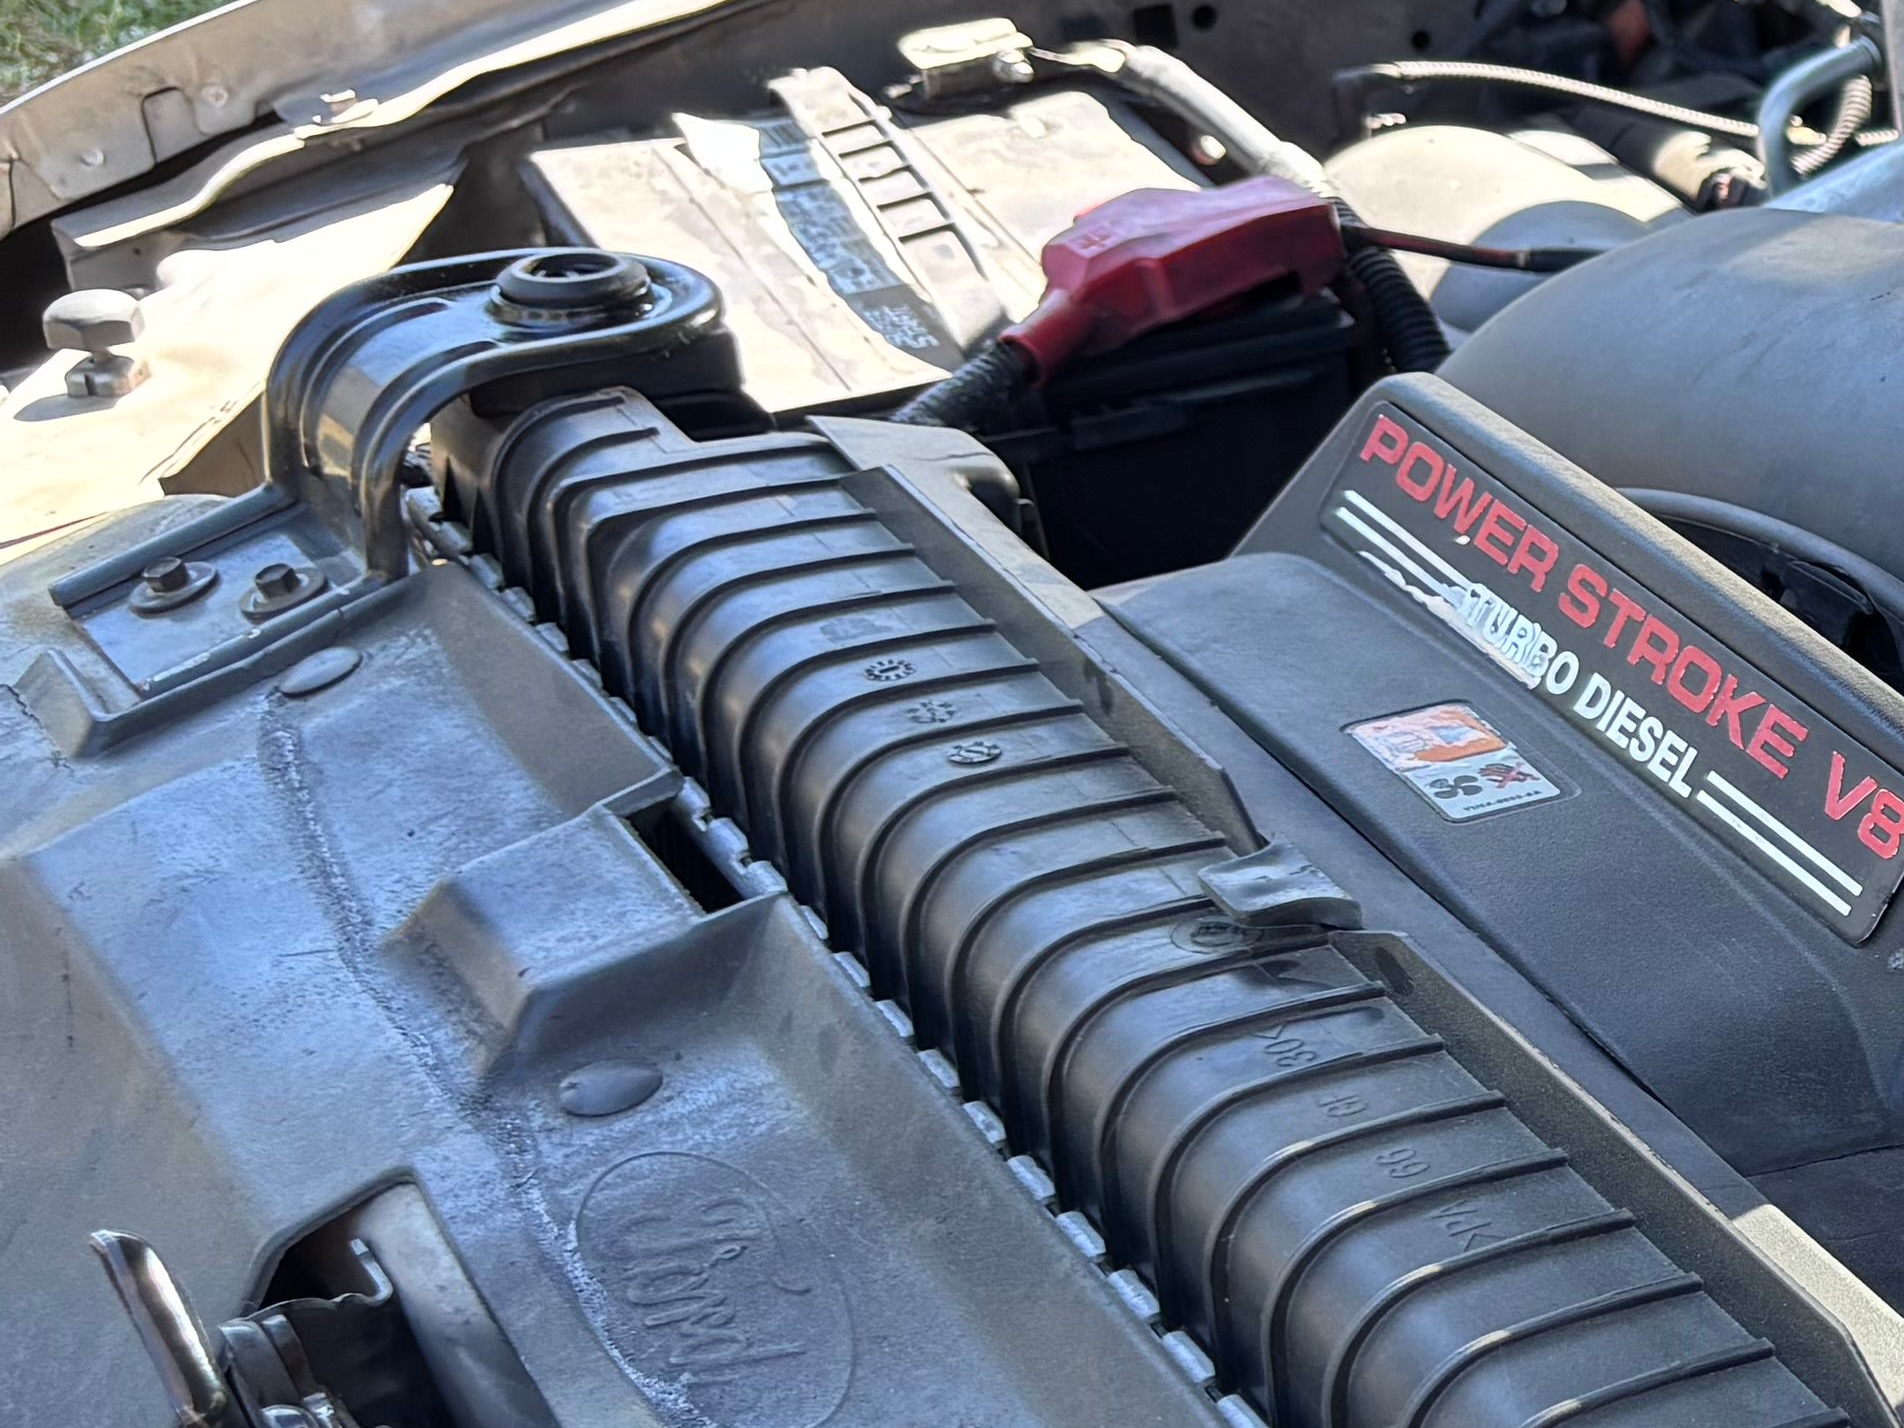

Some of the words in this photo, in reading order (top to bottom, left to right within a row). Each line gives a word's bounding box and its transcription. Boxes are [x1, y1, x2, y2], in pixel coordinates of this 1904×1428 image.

[1359, 414, 1559, 592] POWER
[1557, 563, 1808, 780] STROKE
[1463, 584, 1580, 695] TURBO
[1577, 673, 1700, 799] DIESEL
